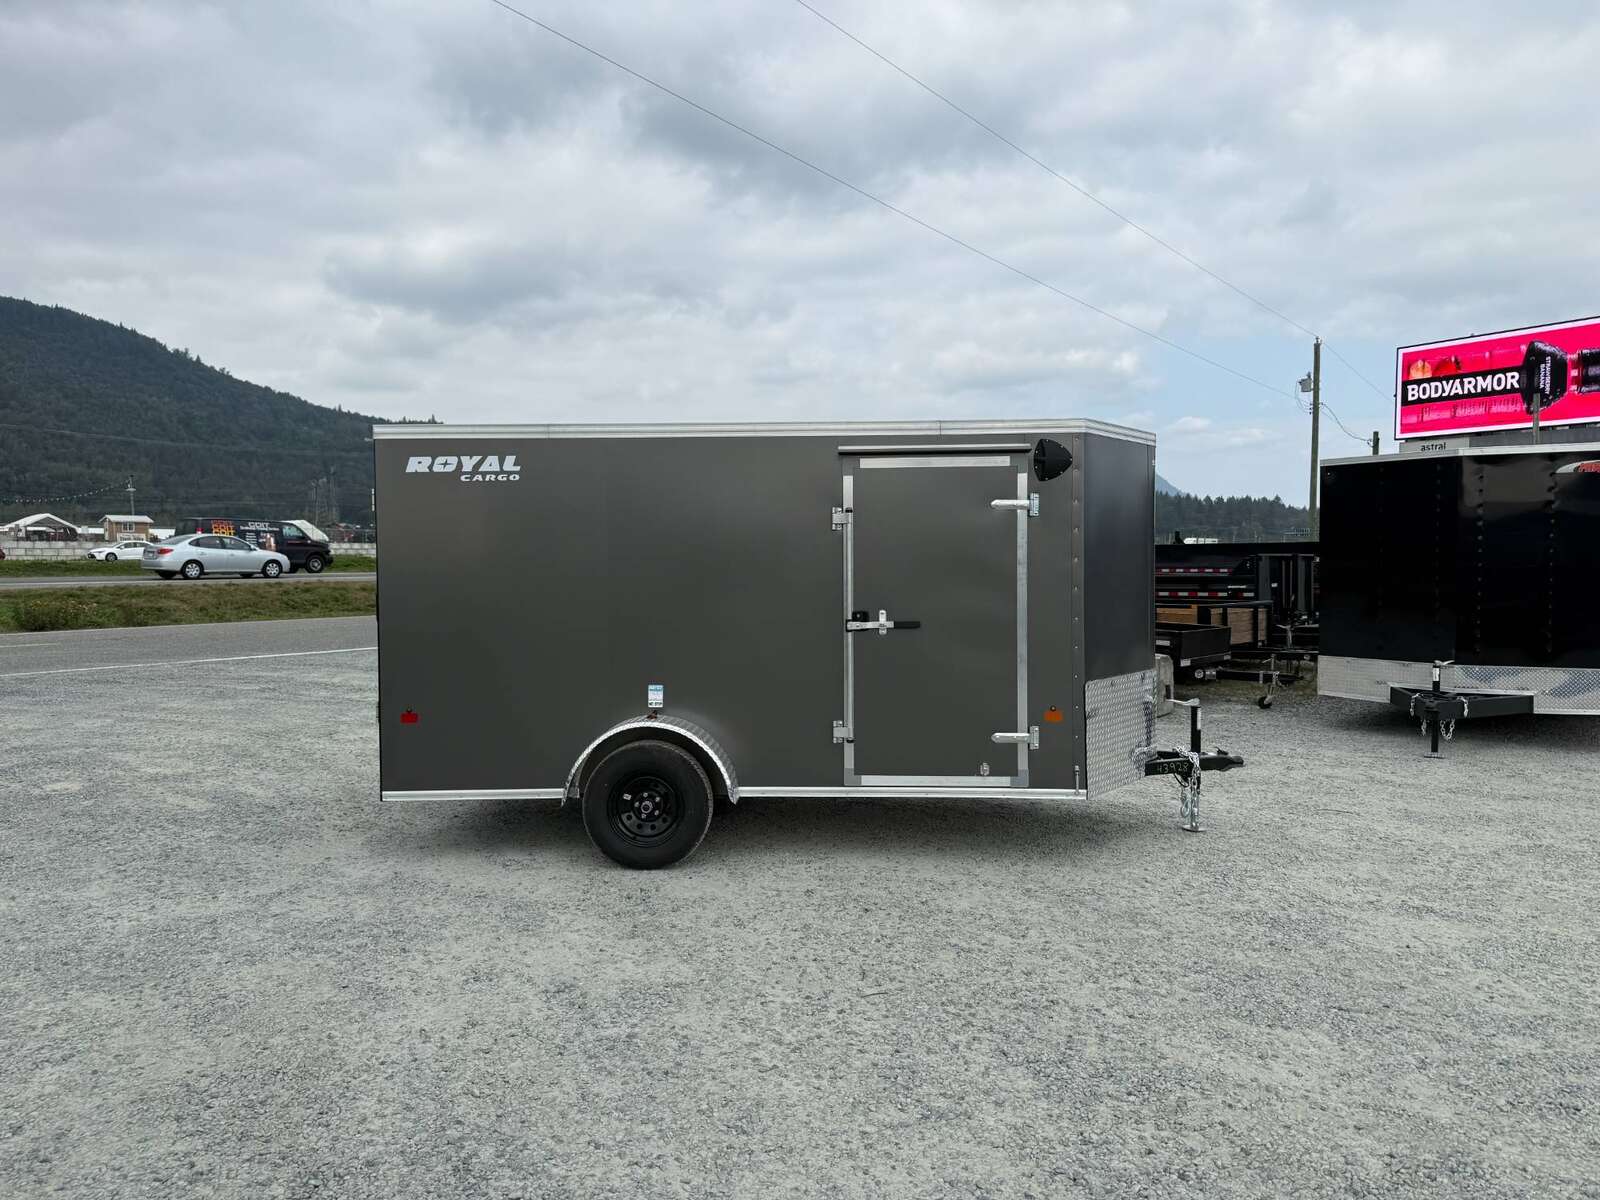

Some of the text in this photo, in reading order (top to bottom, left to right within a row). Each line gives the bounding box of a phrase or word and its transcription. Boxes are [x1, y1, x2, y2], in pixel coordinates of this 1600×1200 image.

[1407, 371, 1520, 401] BODYARMOR
[1420, 442, 1447, 452] astral
[405, 455, 521, 472] ROYAL
